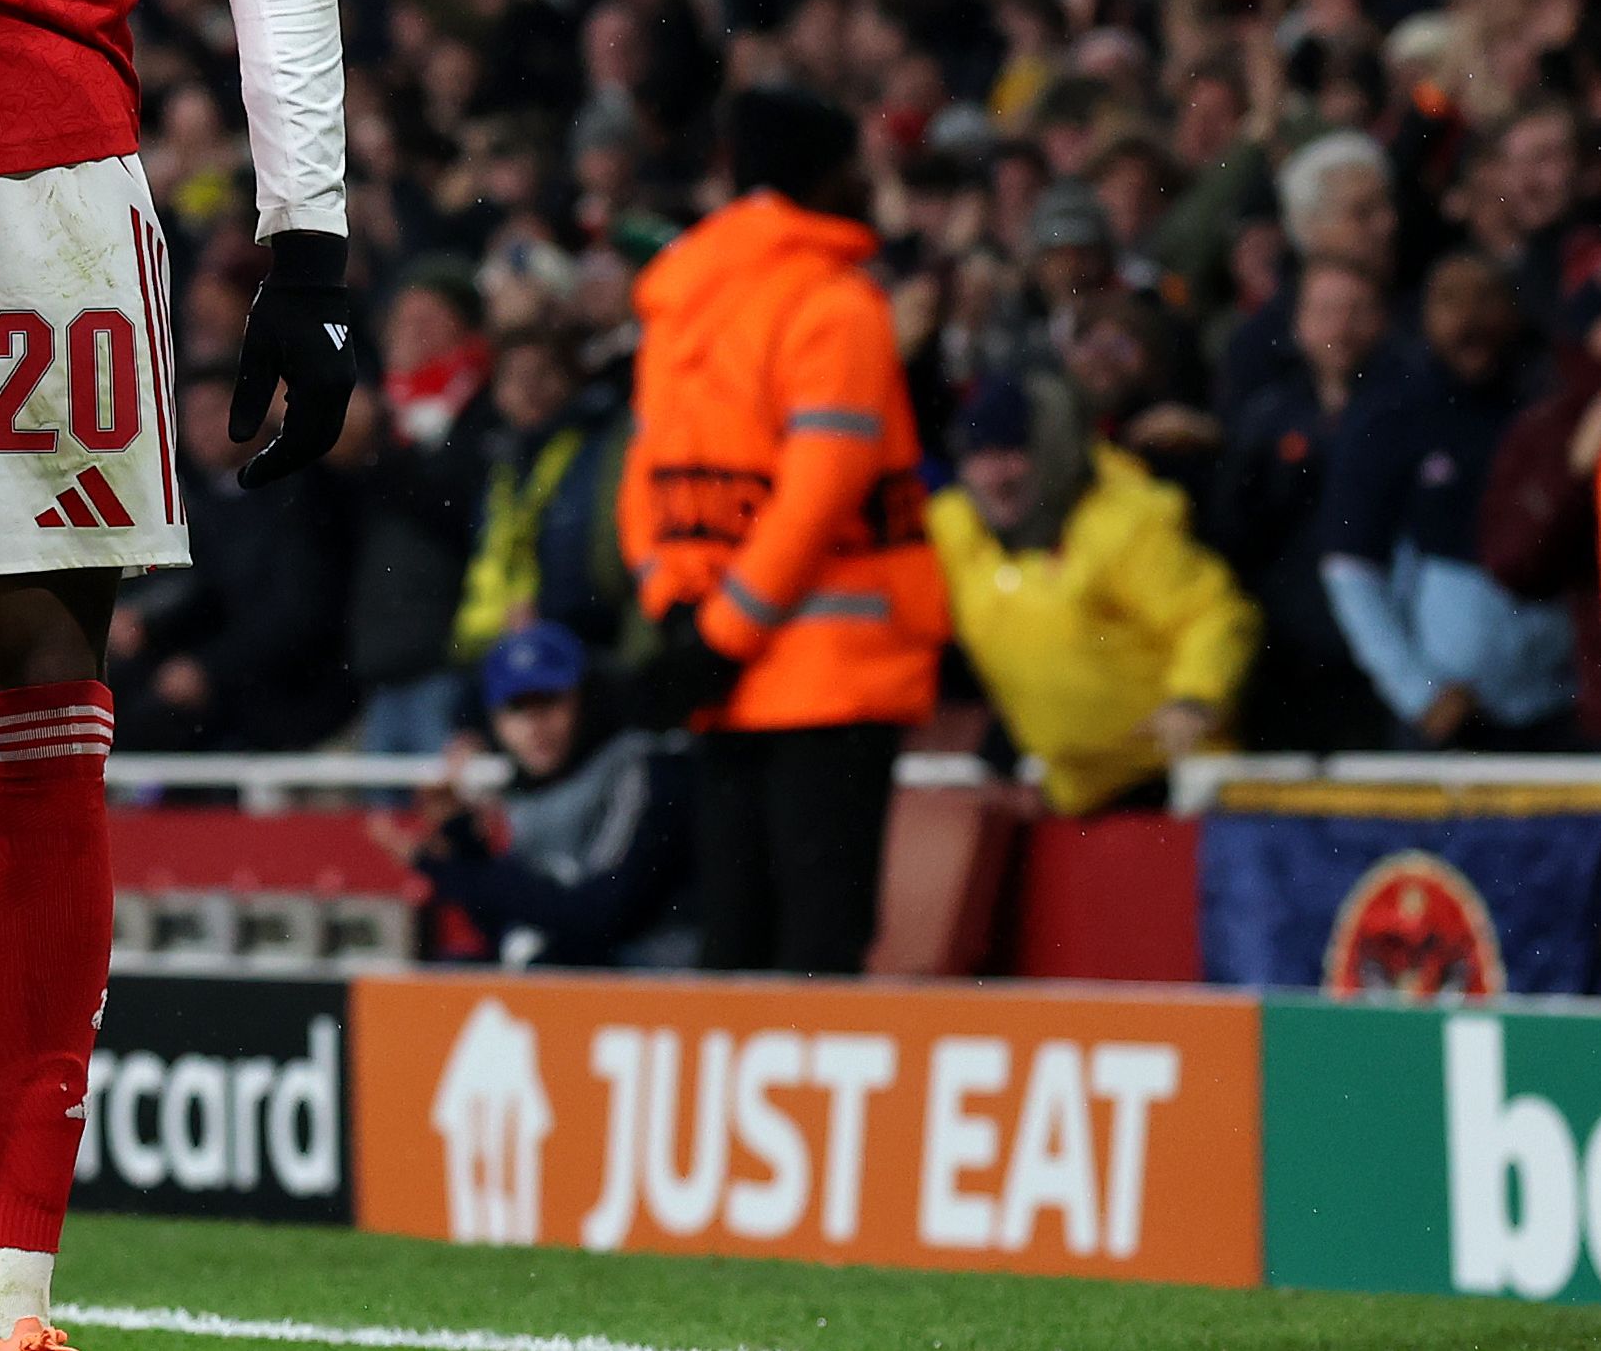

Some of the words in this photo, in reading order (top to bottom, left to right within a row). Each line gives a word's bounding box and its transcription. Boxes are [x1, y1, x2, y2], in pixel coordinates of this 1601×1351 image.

[581, 1024, 896, 1254] JUST
[917, 1035, 1180, 1259] EAT
[1443, 1015, 1601, 1301] b
